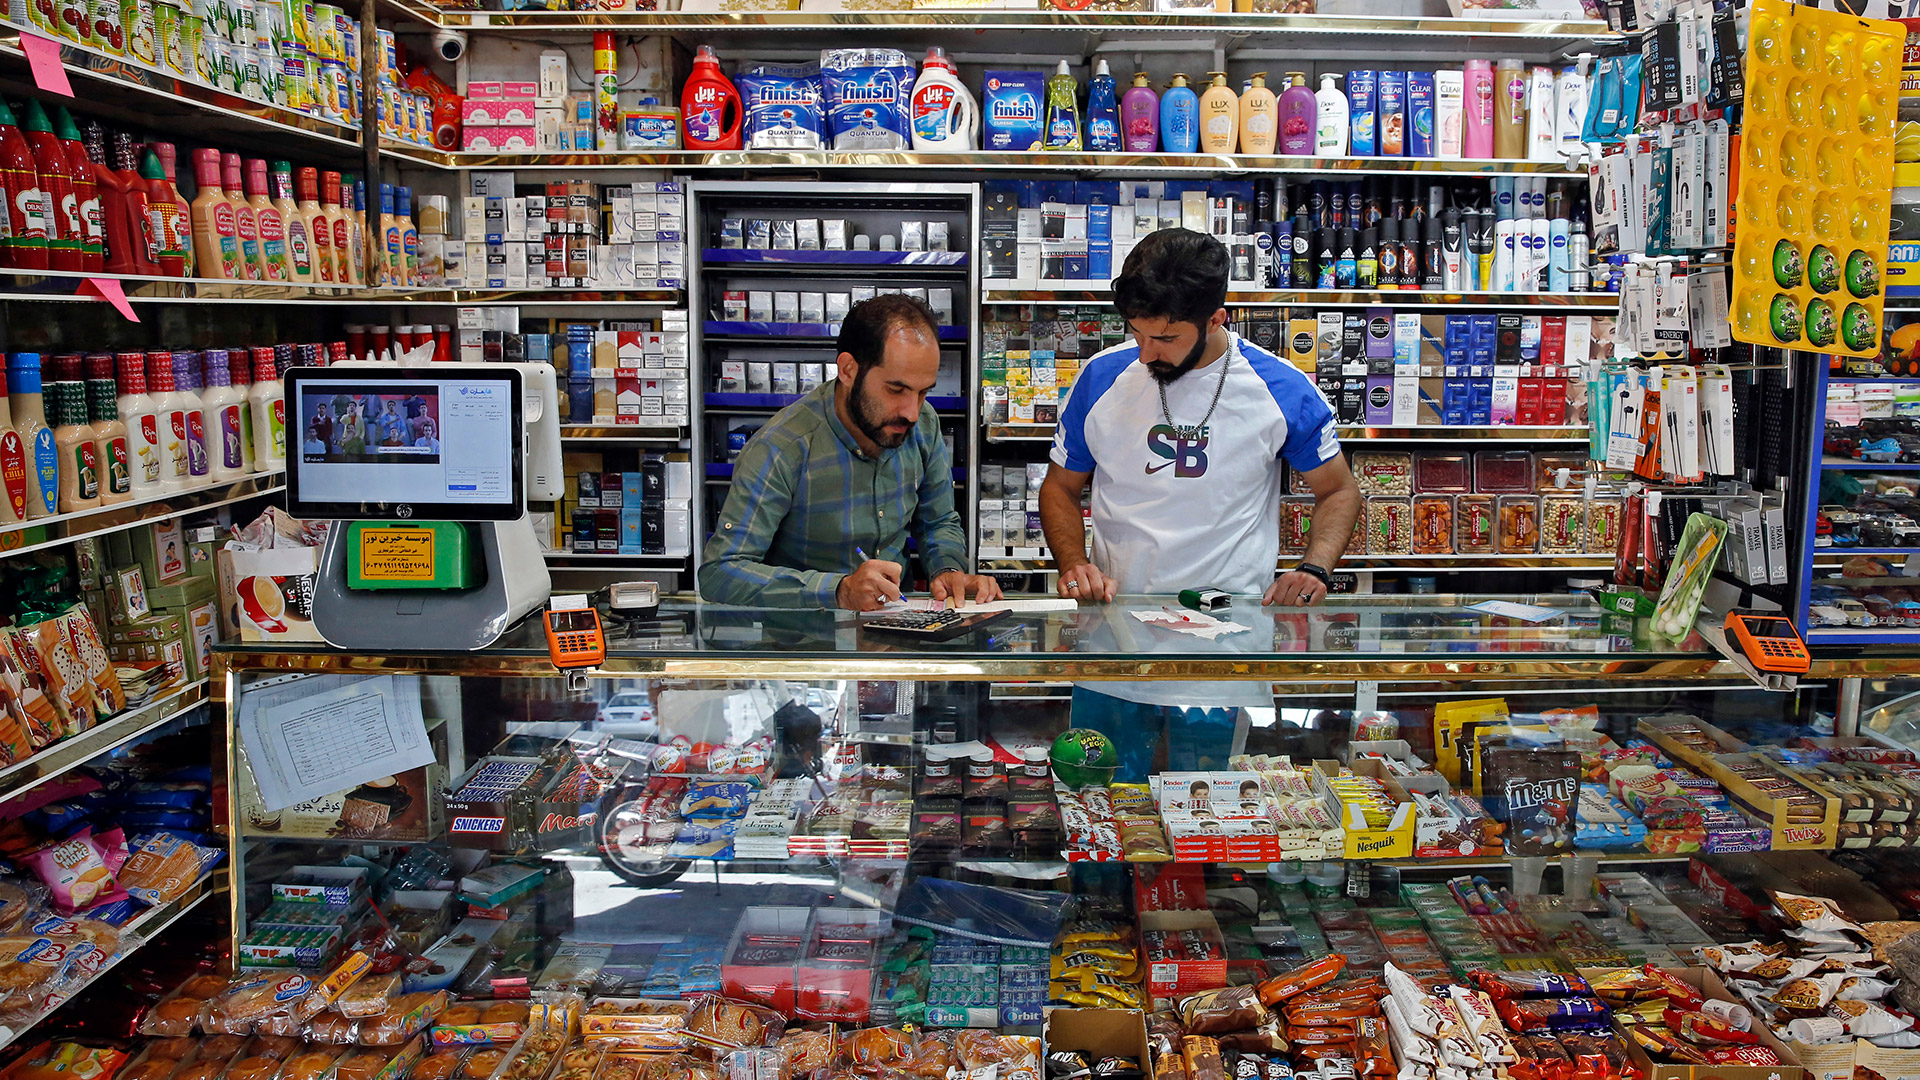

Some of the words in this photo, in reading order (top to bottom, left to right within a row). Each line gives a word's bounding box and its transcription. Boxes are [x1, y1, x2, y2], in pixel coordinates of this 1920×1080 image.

[841, 80, 894, 101] finish
[1351, 84, 1374, 93] CLEAR
[1380, 86, 1402, 95] CLEAR
[1409, 84, 1432, 93] CLEAR
[1440, 84, 1461, 93] CLEAR
[1564, 82, 1582, 90] Dove
[760, 86, 814, 101] finish
[993, 99, 1034, 117] finish
[1131, 102, 1150, 110] LUX
[1173, 99, 1192, 107] LUX
[1210, 100, 1230, 109] LUX
[1250, 99, 1270, 107] LUX
[1286, 101, 1305, 109] LUX
[1319, 100, 1336, 108] Dove
[767, 128, 806, 137] QUANTUM
[1053, 122, 1072, 133] finish
[849, 129, 887, 138] QUANTUM
[1645, 392, 1661, 405] Cable
[1146, 424, 1209, 478] SB
[4, 469, 25, 479] CHILI
[365, 533, 377, 543] نور
[405, 535, 430, 544] موسسه
[1746, 525, 1754, 551] CHARGER
[1752, 525, 1761, 551] TRAVEL
[1769, 525, 1777, 551] CHARGER
[1775, 525, 1784, 551] TRAVEL
[1080, 735, 1107, 745] HAPPY
[1089, 740, 1106, 748] EGG
[1505, 777, 1577, 810] m&m's
[1113, 796, 1150, 805] Nesquik
[453, 817, 505, 832] SNICKERS
[538, 812, 598, 833] Mars
[1784, 827, 1819, 843] Twix
[1357, 836, 1395, 853] Nesquik
[1715, 844, 1751, 853] mentos
[53, 839, 85, 864] CAKE
[61, 847, 91, 870] MAKE
[1457, 961, 1489, 969] Trident
